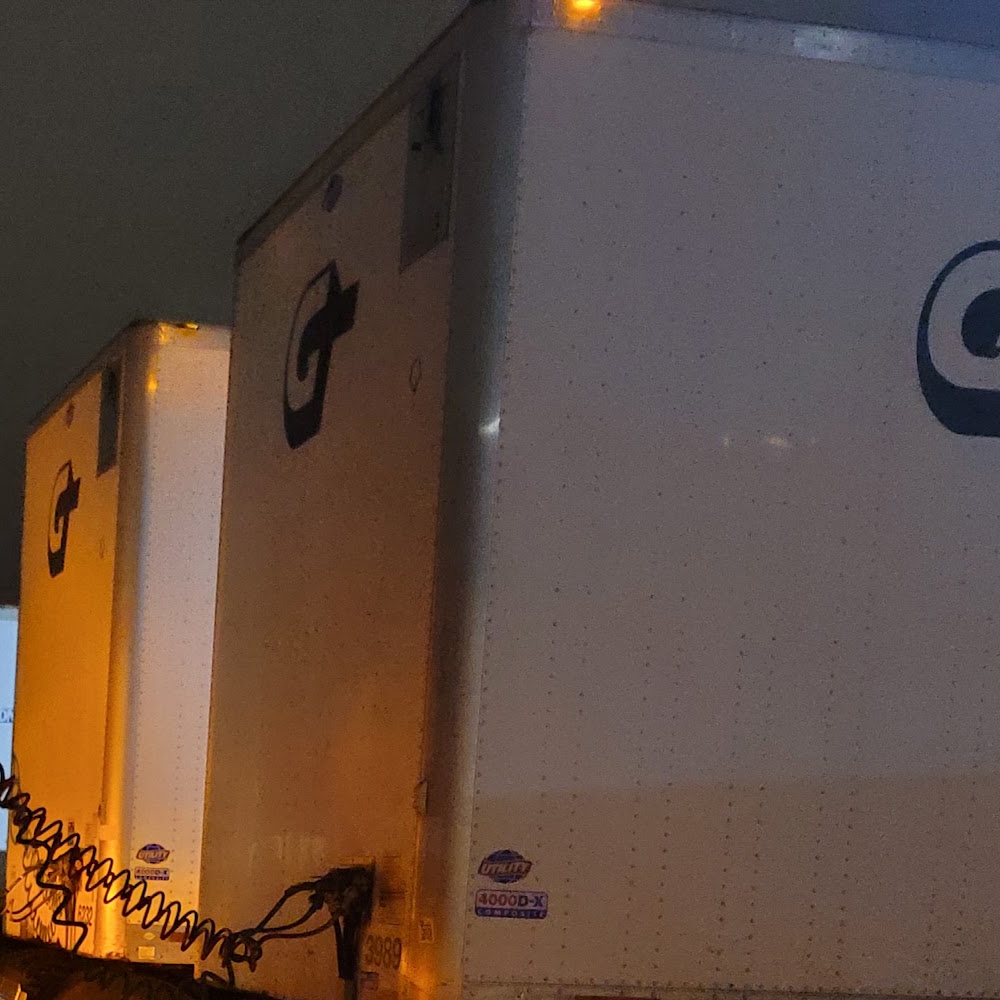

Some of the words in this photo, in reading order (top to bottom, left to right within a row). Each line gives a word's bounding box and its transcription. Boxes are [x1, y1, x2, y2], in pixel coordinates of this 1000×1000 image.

[481, 862, 529, 876] UTILITY
[478, 892, 544, 907] 4000D-X
[477, 909, 546, 918] COMPOSITE
